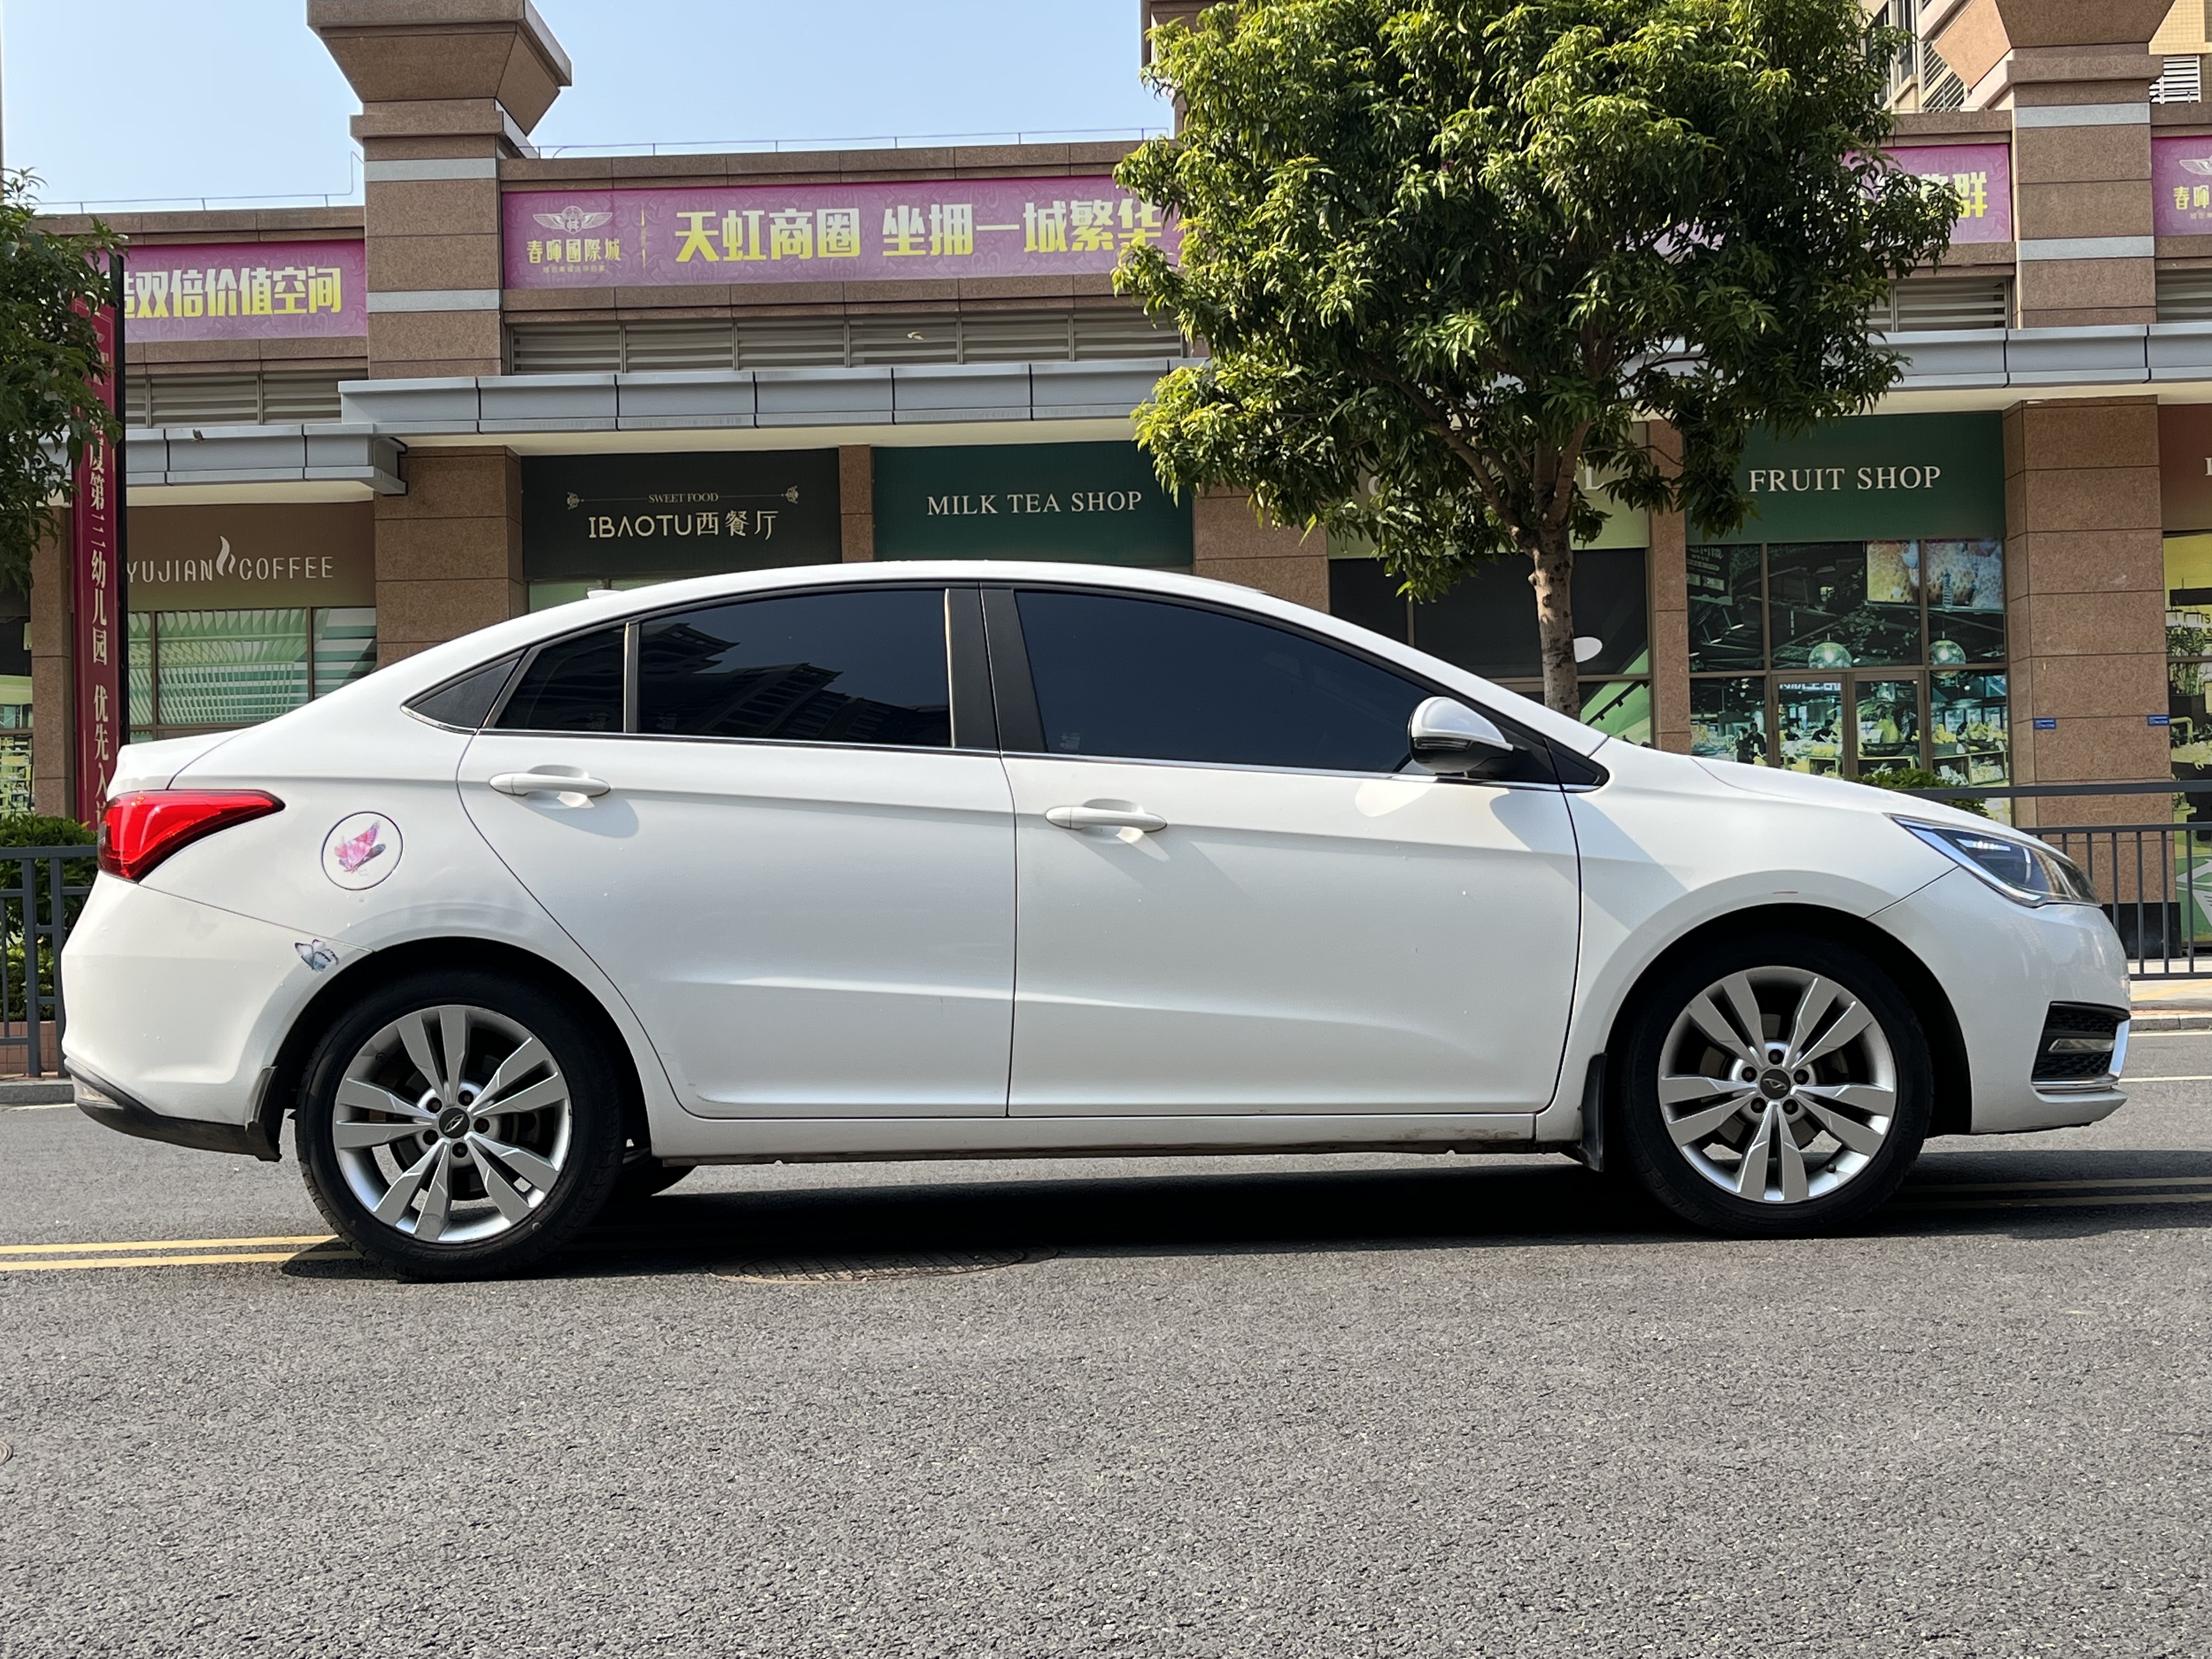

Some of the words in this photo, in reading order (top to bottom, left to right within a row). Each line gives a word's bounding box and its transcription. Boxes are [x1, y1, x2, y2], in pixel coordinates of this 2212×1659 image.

[675, 208, 860, 262] 天虹商圈
[882, 199, 1162, 256] 坐拥一城繁华
[1748, 467, 1845, 492] FRUIT
[1857, 466, 1942, 490] SHOP
[648, 494, 685, 504] SWEET
[687, 493, 719, 503] FOOD
[927, 495, 998, 516] MILK
[1007, 493, 1061, 514] TEA
[1071, 491, 1143, 512] SHOP
[127, 558, 213, 583] YUJIAN
[239, 556, 334, 580] COFFEE
